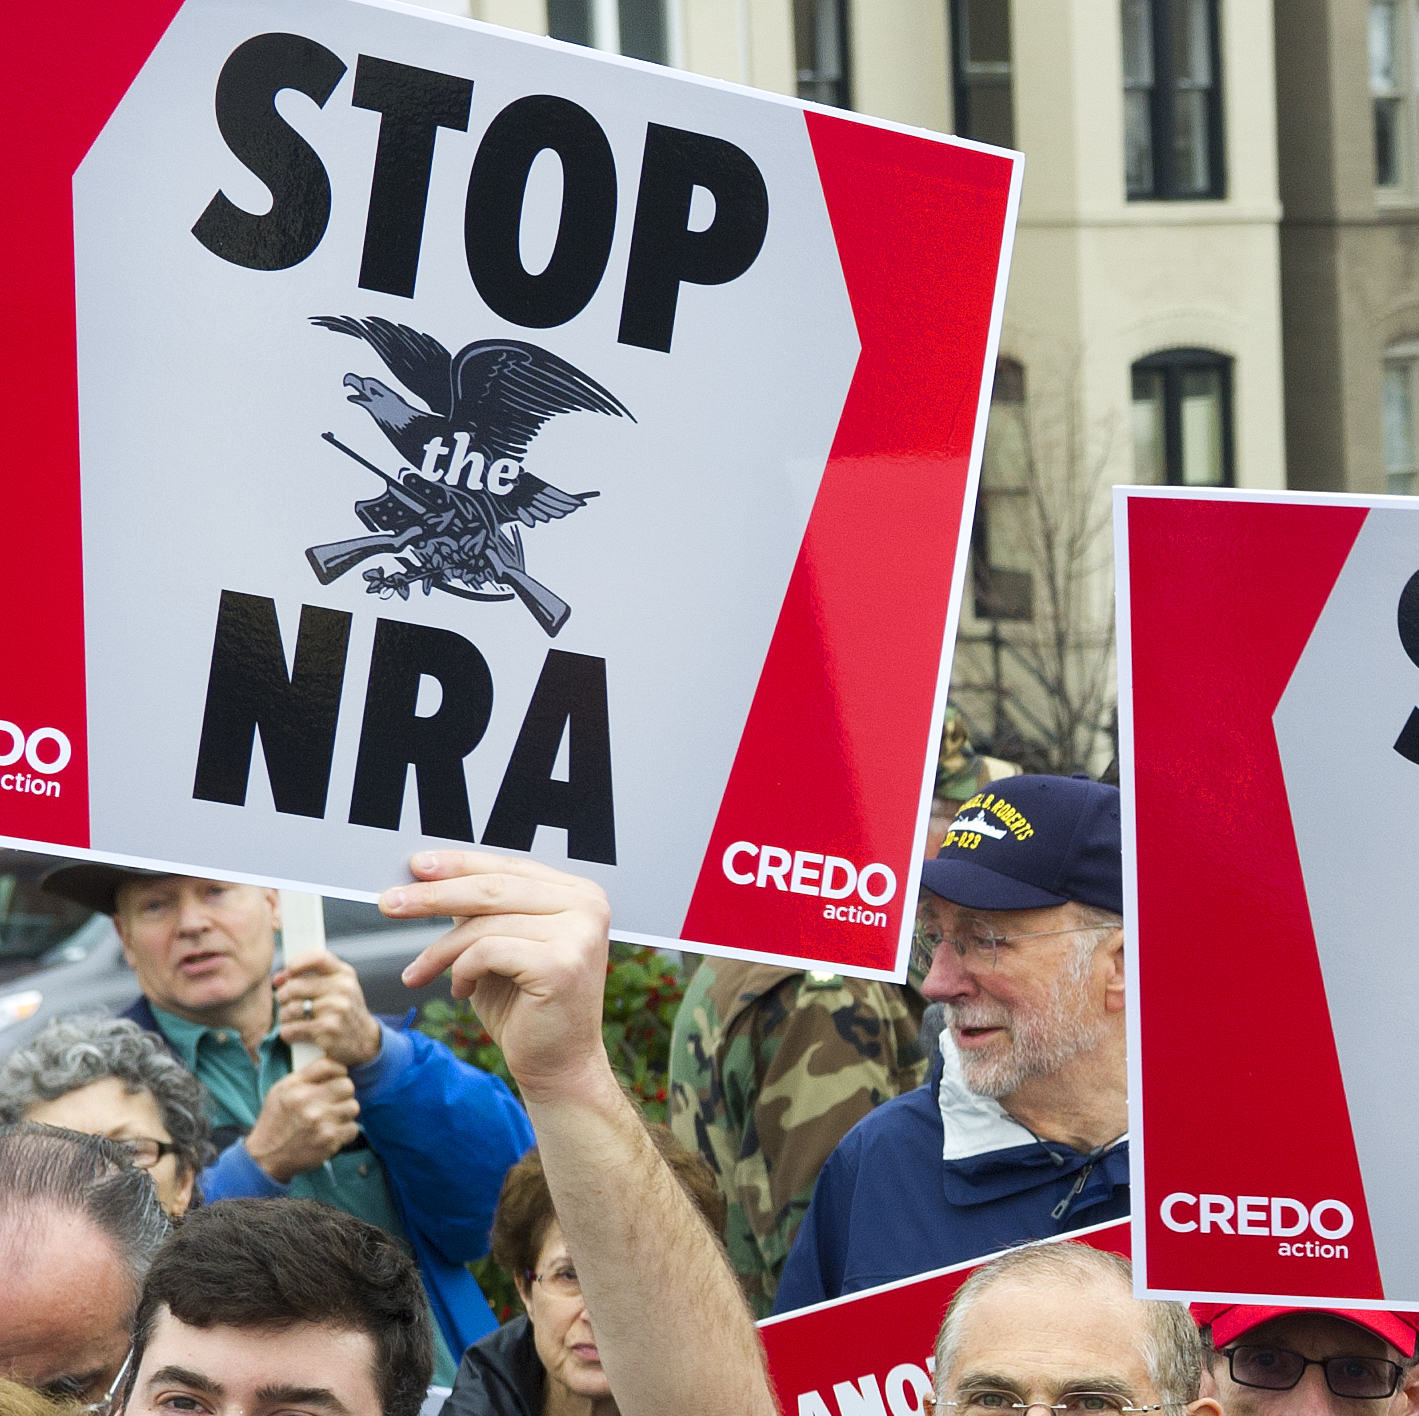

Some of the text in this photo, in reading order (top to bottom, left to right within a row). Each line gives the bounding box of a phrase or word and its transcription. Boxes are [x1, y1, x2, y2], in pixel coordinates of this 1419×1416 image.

[192, 33, 769, 353] STOP
[422, 431, 520, 496] the
[193, 589, 617, 866] NRA
[0, 772, 61, 798] ction
[990, 798, 1035, 841] ROBERTS
[723, 841, 895, 907] CREDO
[824, 903, 888, 927] action
[1161, 1192, 1354, 1239] CREDO
[1278, 1242, 1349, 1260] action
